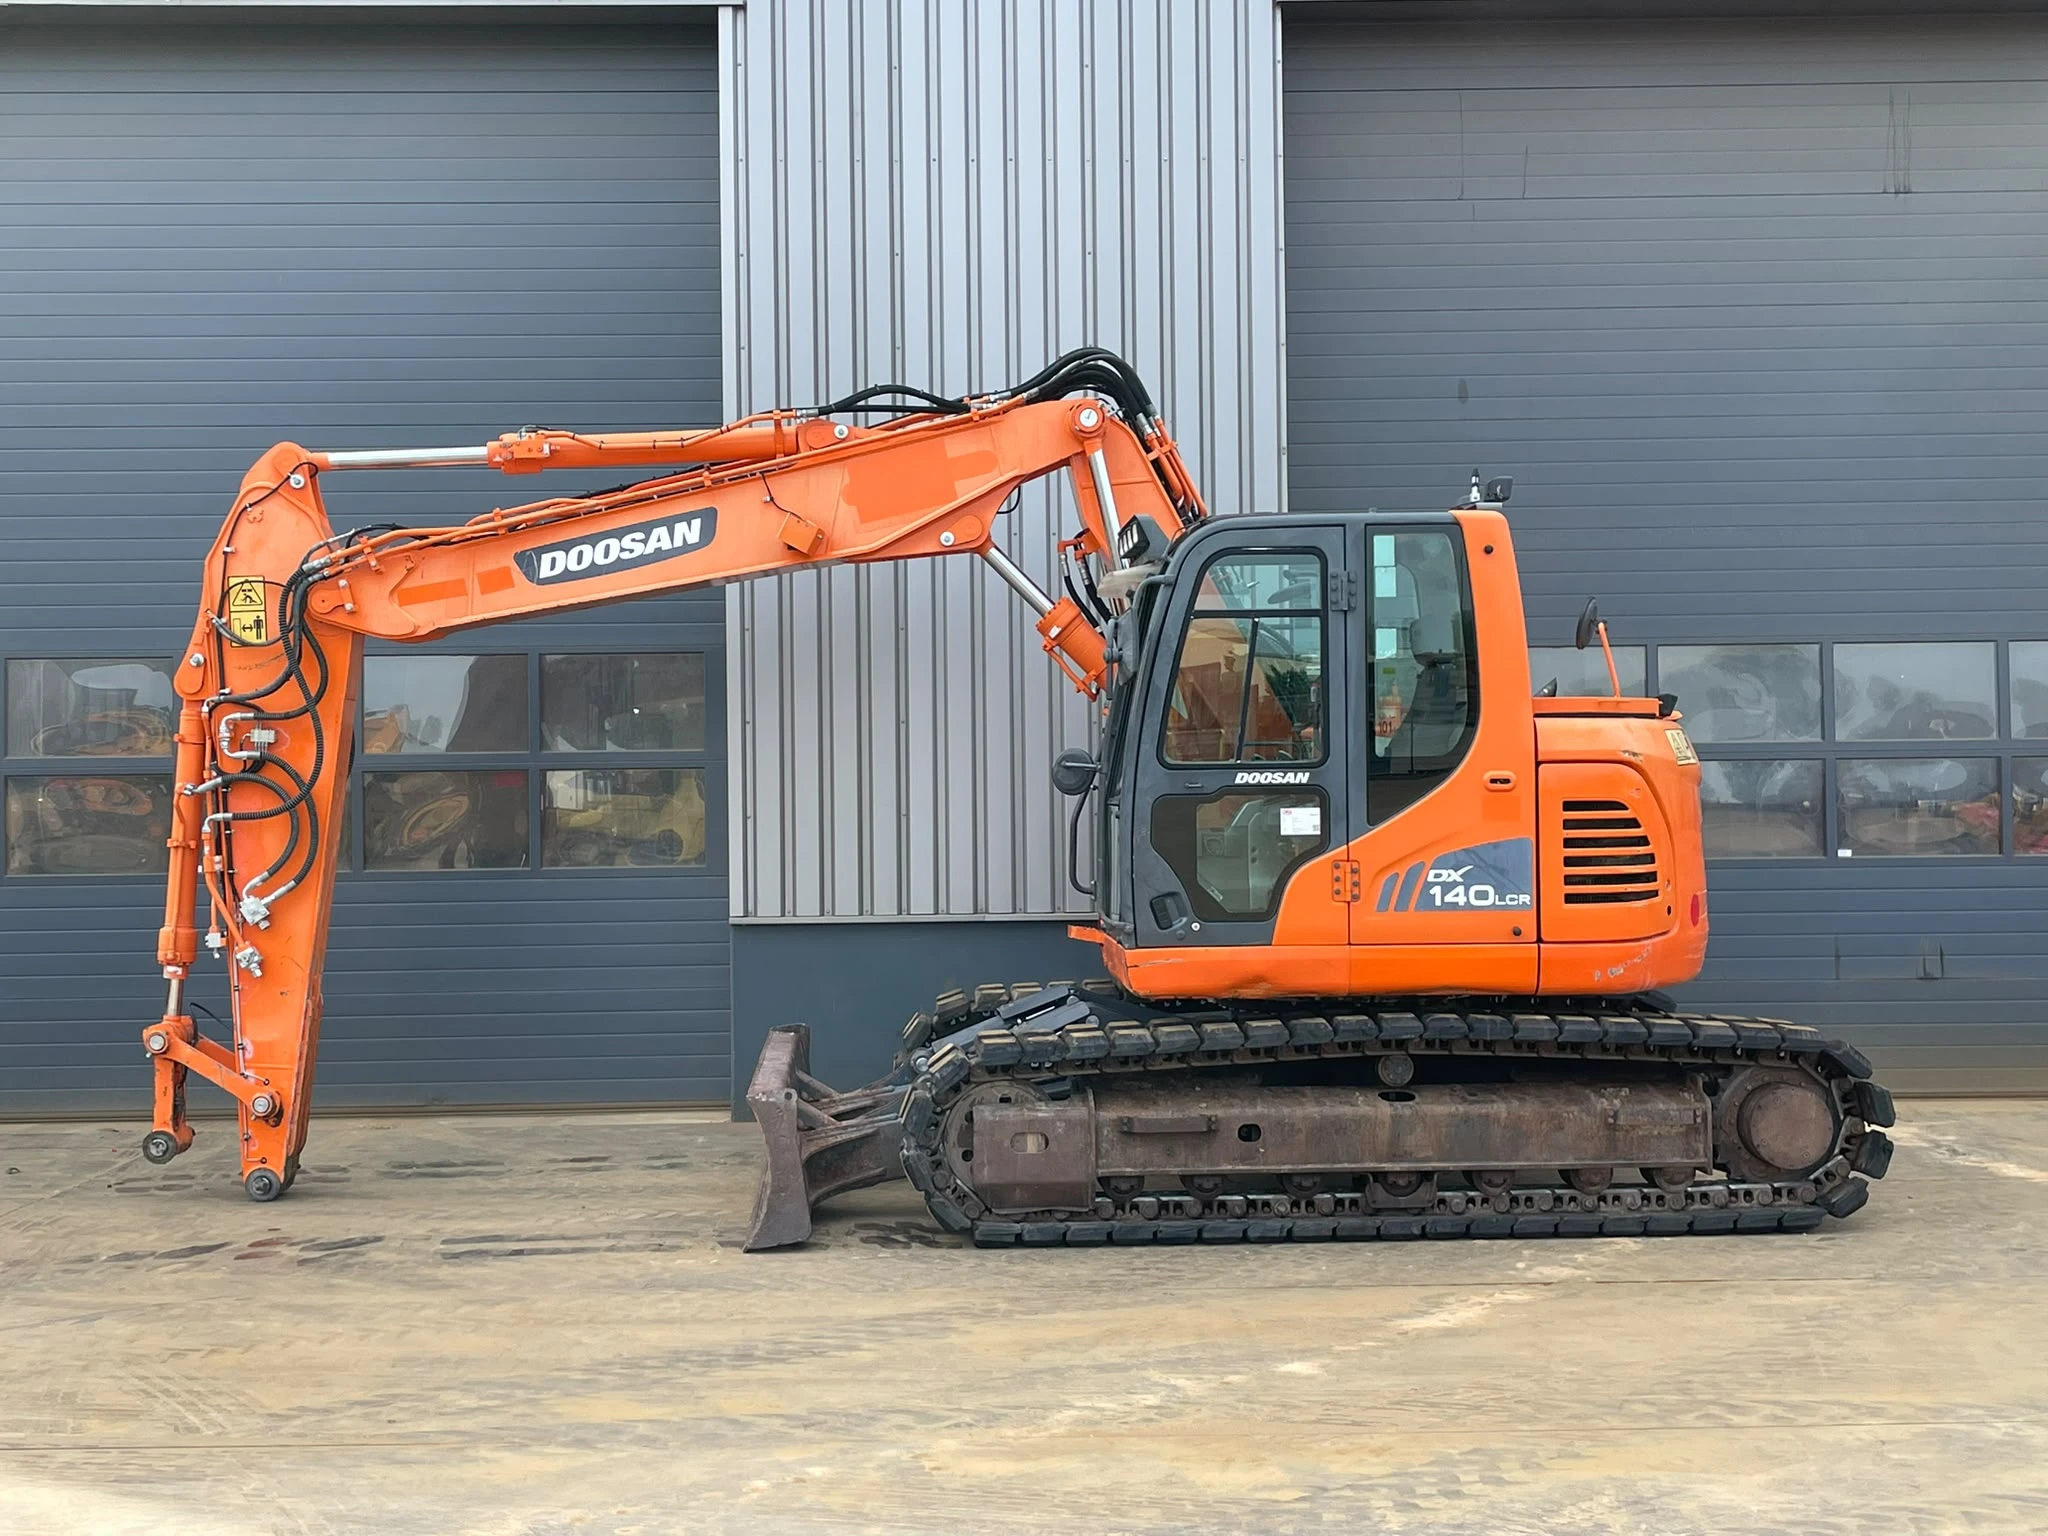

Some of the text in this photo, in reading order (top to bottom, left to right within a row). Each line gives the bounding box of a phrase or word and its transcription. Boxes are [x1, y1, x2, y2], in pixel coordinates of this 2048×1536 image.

[539, 518, 702, 579] DOOSAN
[1234, 772, 1310, 784] DOOSAN
[1426, 865, 1474, 882] DX
